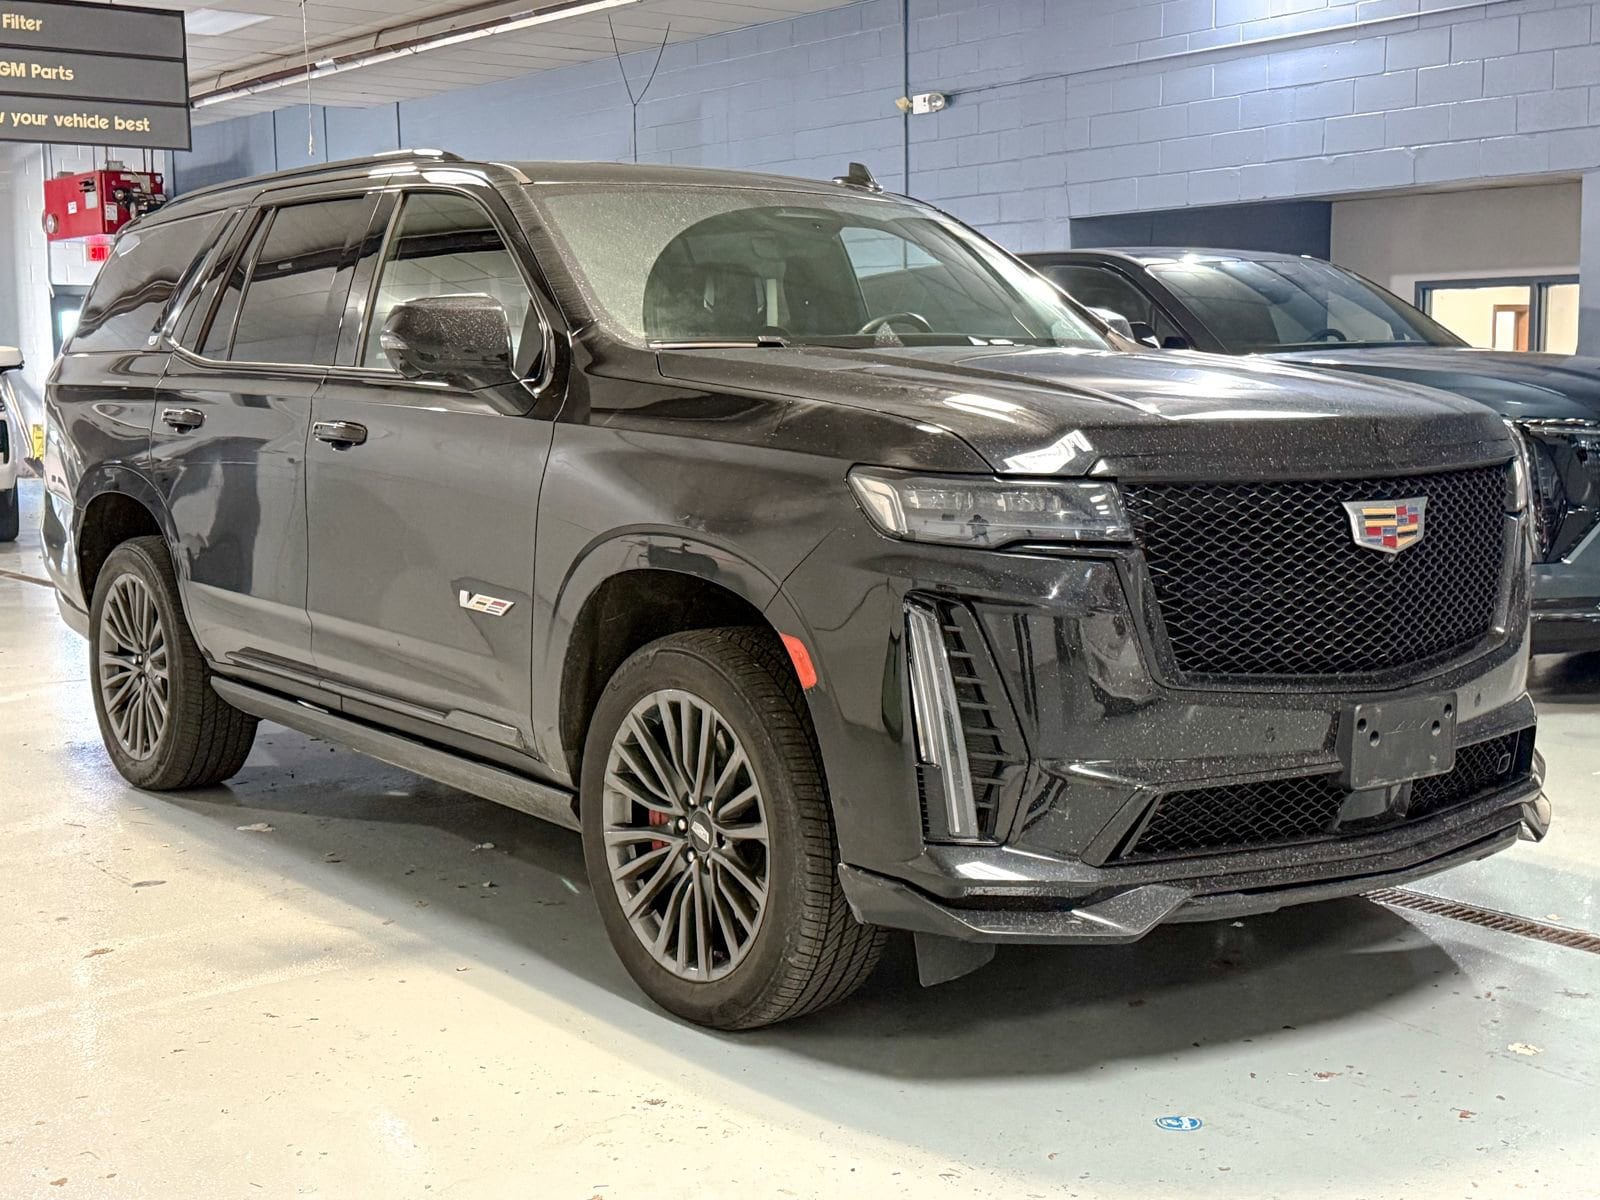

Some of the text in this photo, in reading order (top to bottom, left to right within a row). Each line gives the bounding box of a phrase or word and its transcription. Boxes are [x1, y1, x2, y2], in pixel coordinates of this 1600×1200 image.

[2, 14, 42, 31] Filter
[0, 62, 74, 81] GM Parts
[10, 112, 48, 127] your
[53, 113, 109, 130] vehicle
[114, 116, 150, 132] best
